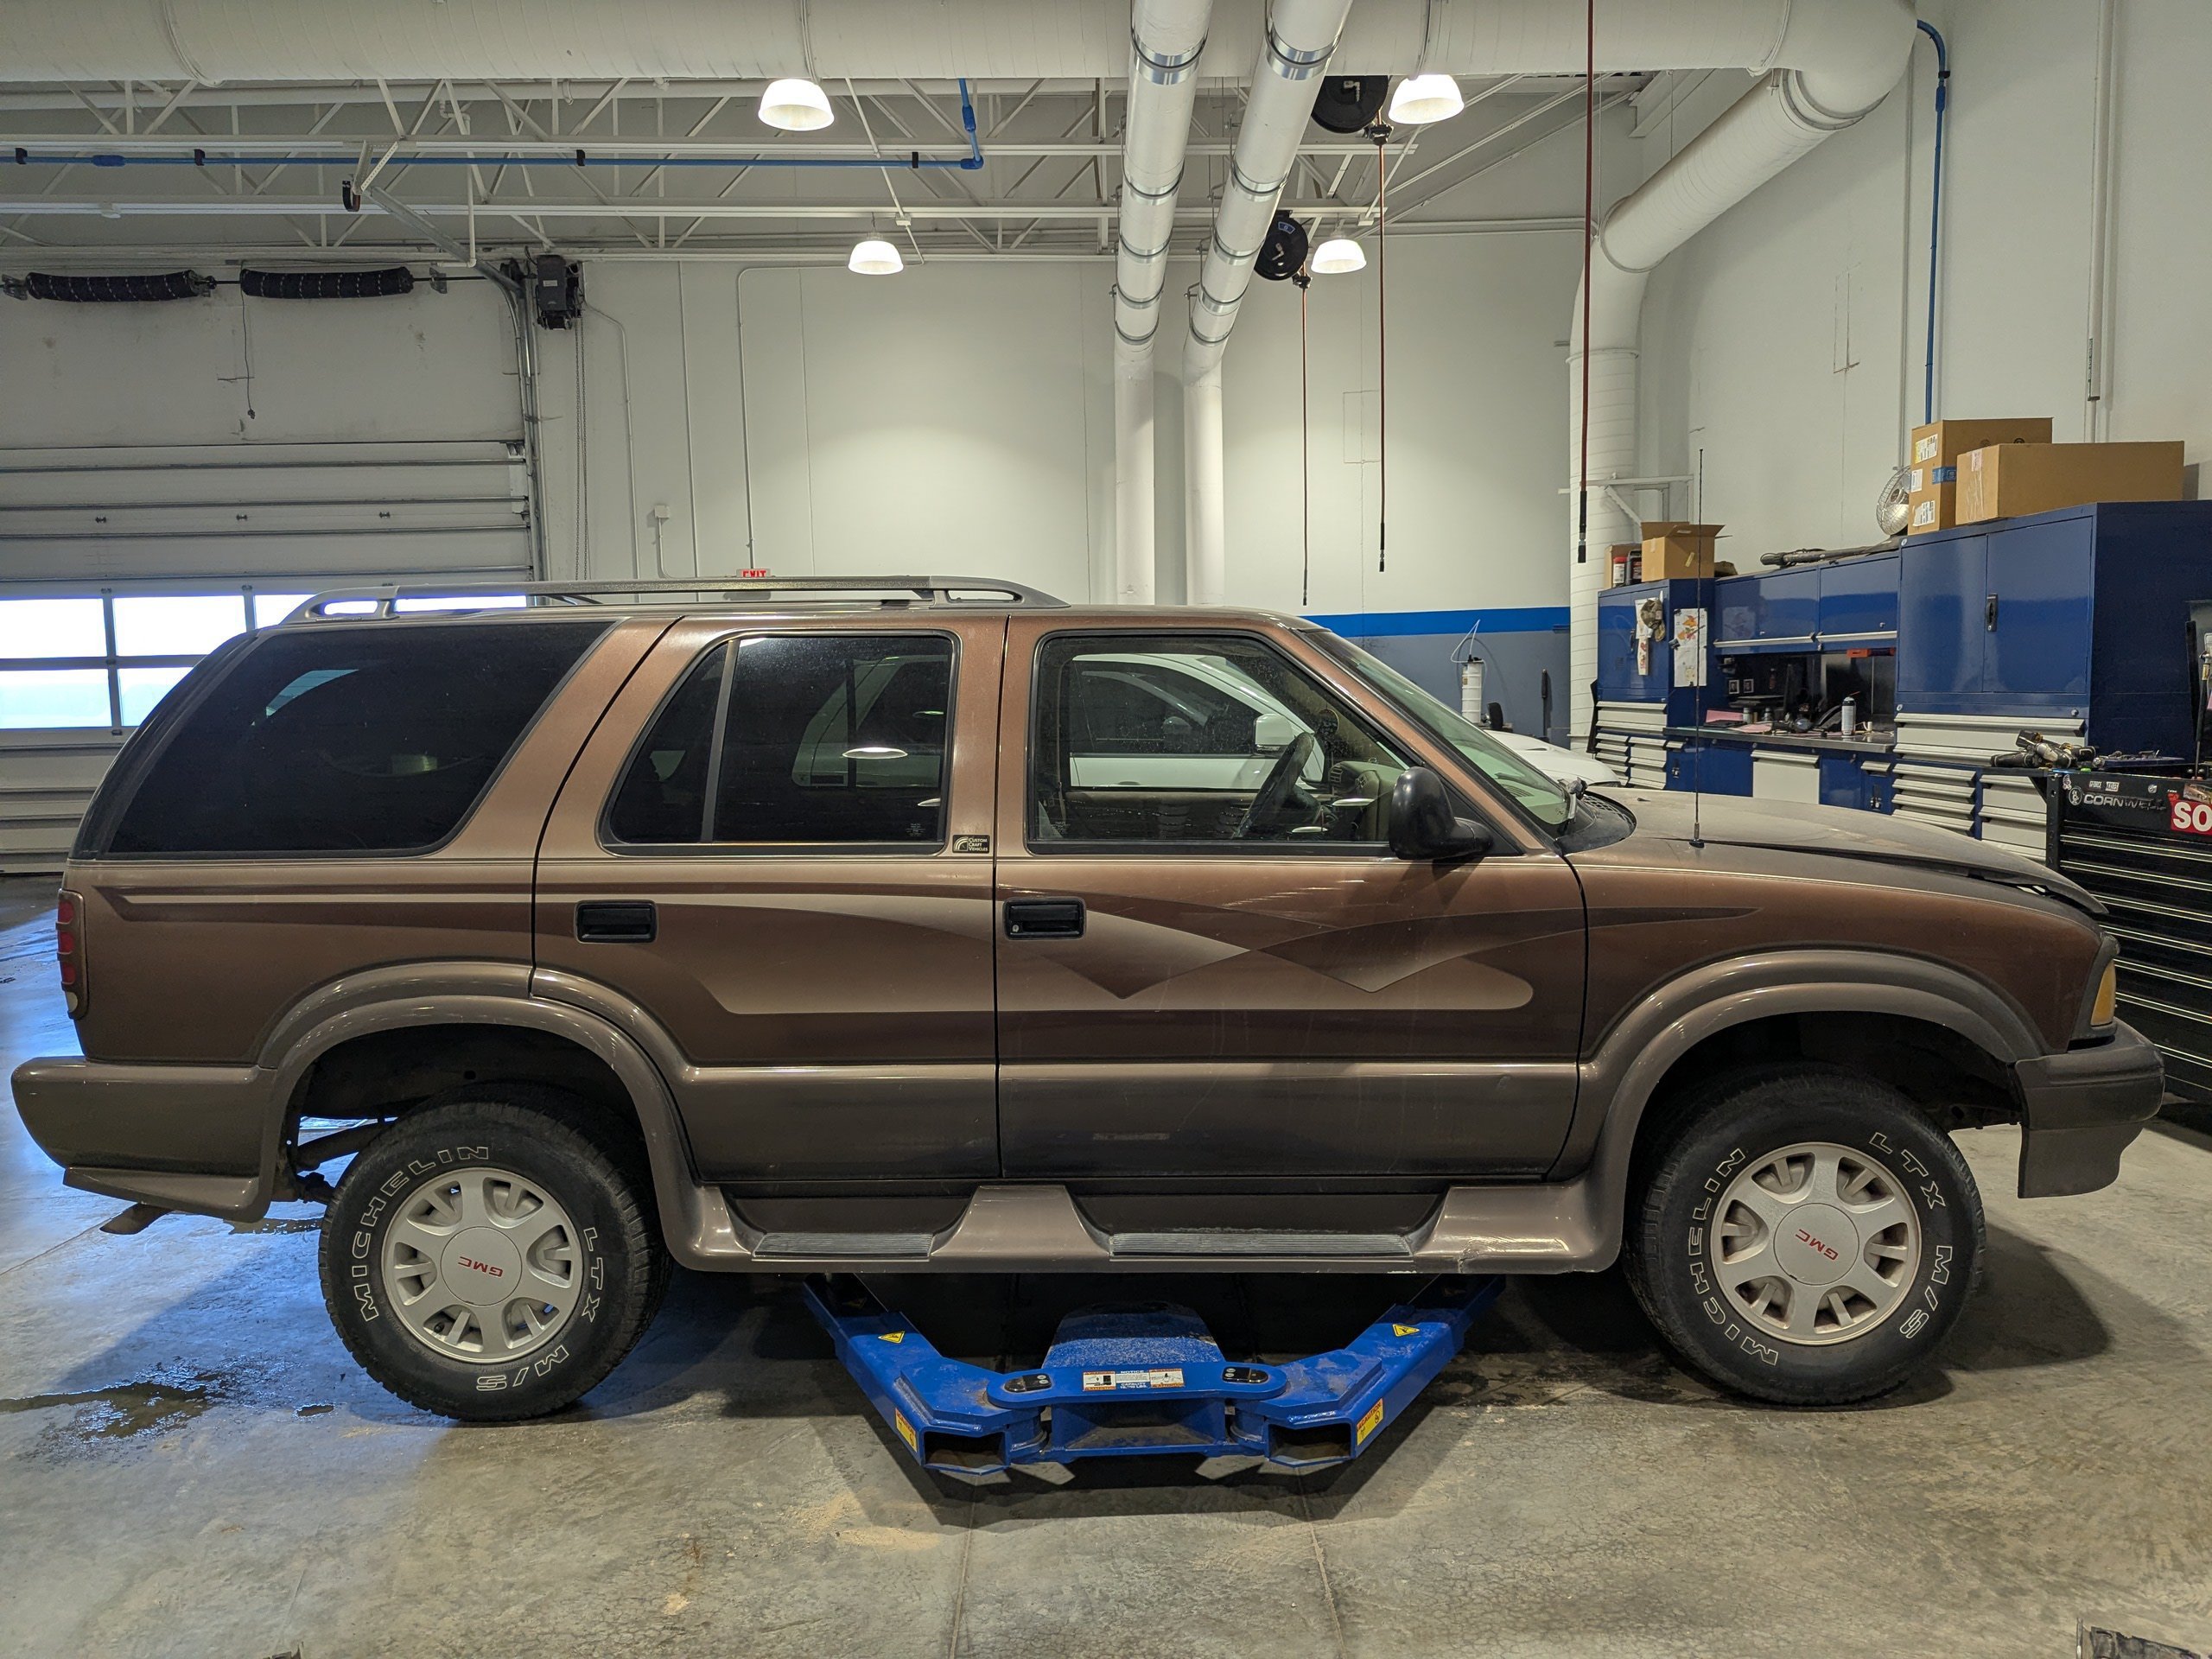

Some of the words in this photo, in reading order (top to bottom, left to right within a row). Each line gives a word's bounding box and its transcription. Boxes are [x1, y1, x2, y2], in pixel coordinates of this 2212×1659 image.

[742, 569, 766, 578] EXIT
[2172, 801, 2212, 832] SO
[1869, 1132, 1946, 1210] LTX
[352, 1146, 489, 1322] MICHELIN
[1688, 1147, 1779, 1366] MICHELIN
[1795, 1229, 1839, 1262] GMC
[458, 1255, 504, 1278] GMC
[582, 1227, 604, 1323] LTX
[1899, 1245, 1953, 1339] M/S
[476, 1345, 570, 1391] M/S
